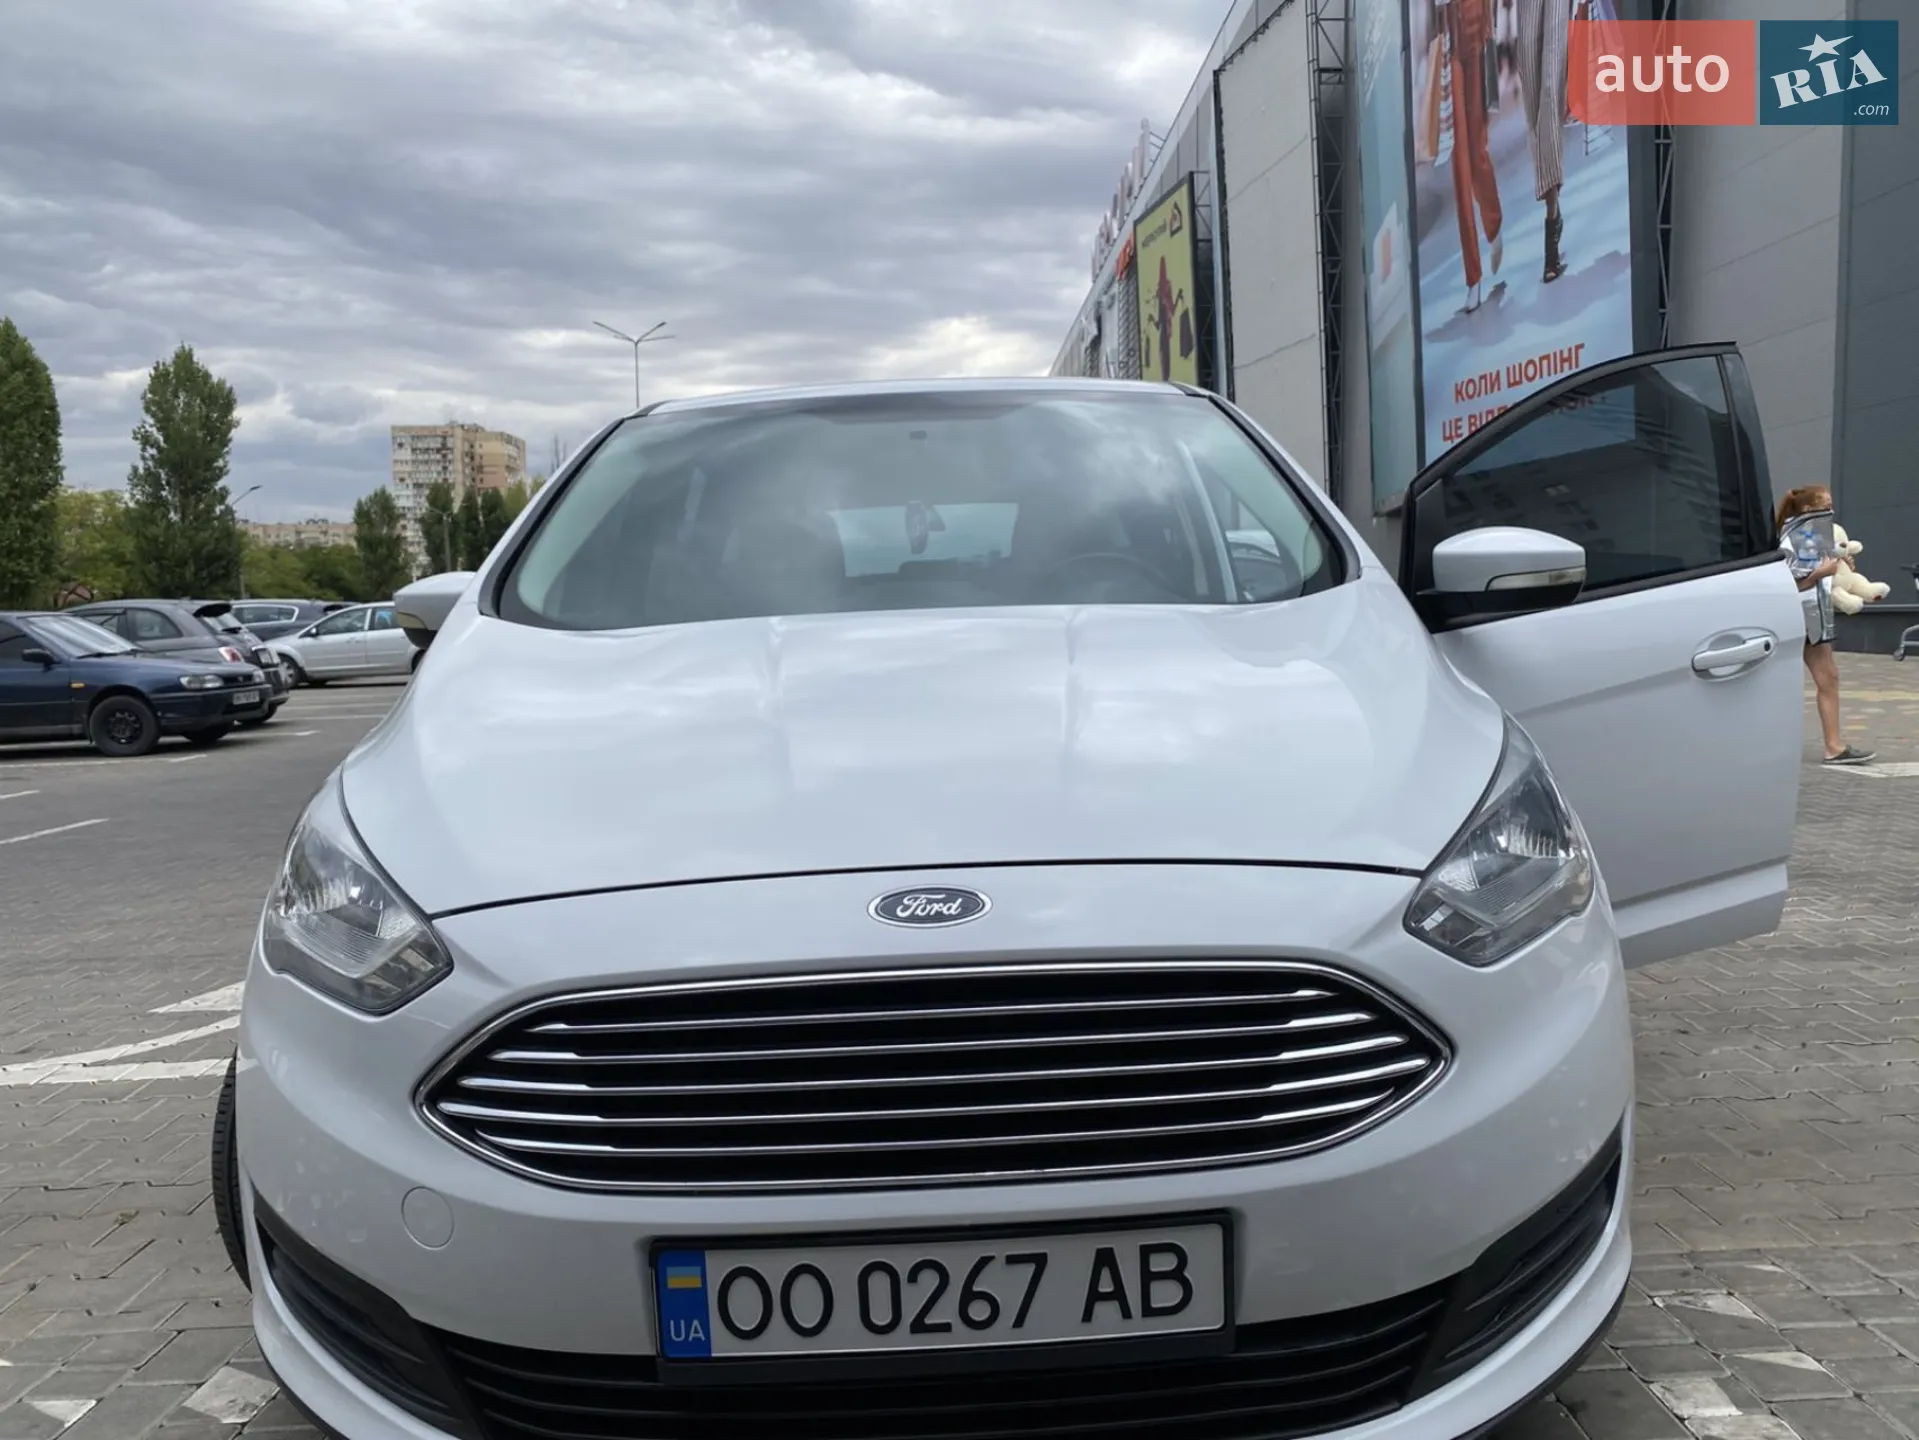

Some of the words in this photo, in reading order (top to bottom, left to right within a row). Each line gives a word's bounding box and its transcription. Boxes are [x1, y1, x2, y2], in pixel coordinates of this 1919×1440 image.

[1454, 369, 1501, 403] КОЛИ
[1506, 343, 1585, 388] ШОПІНГ
[1442, 416, 1463, 443] ЦЕ
[896, 893, 963, 918] Ford
[717, 1262, 835, 1341] OO
[857, 1252, 1049, 1335] 0267
[1080, 1241, 1194, 1324] AB
[669, 1319, 705, 1342] UA
